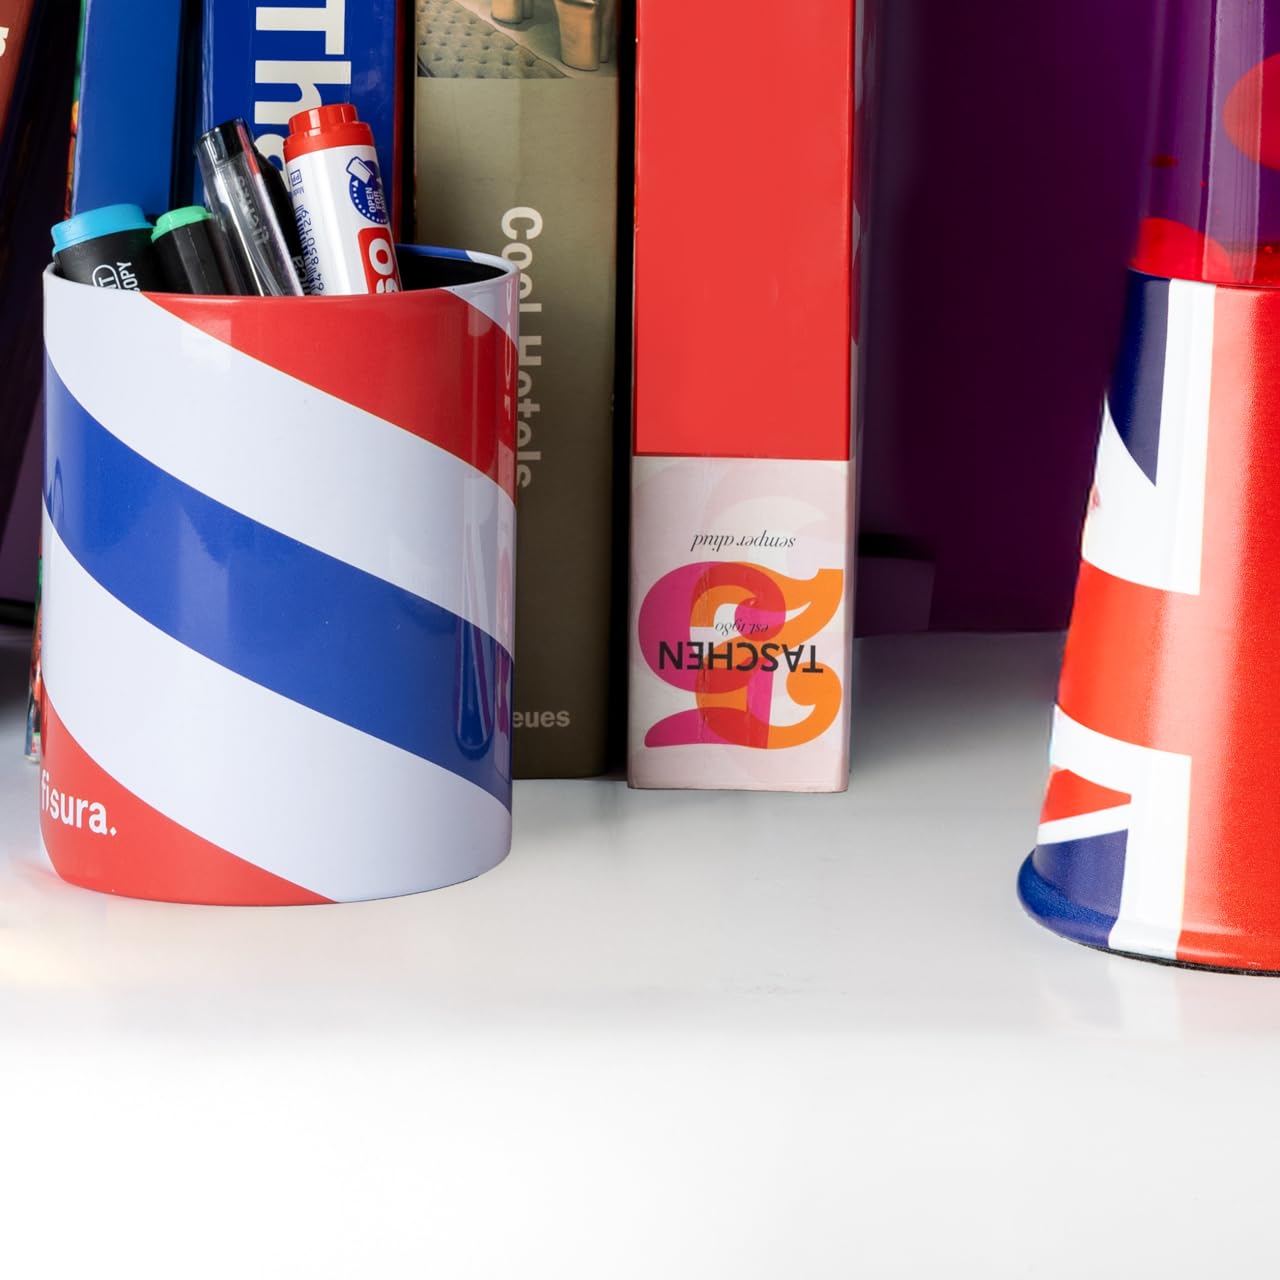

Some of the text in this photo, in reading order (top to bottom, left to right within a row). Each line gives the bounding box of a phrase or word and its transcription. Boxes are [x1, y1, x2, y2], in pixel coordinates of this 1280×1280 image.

[116, 261, 140, 292] OPY
[690, 529, 796, 553] semper aliud
[658, 640, 824, 674] TASCHEN
[41, 768, 118, 837] fisura.
